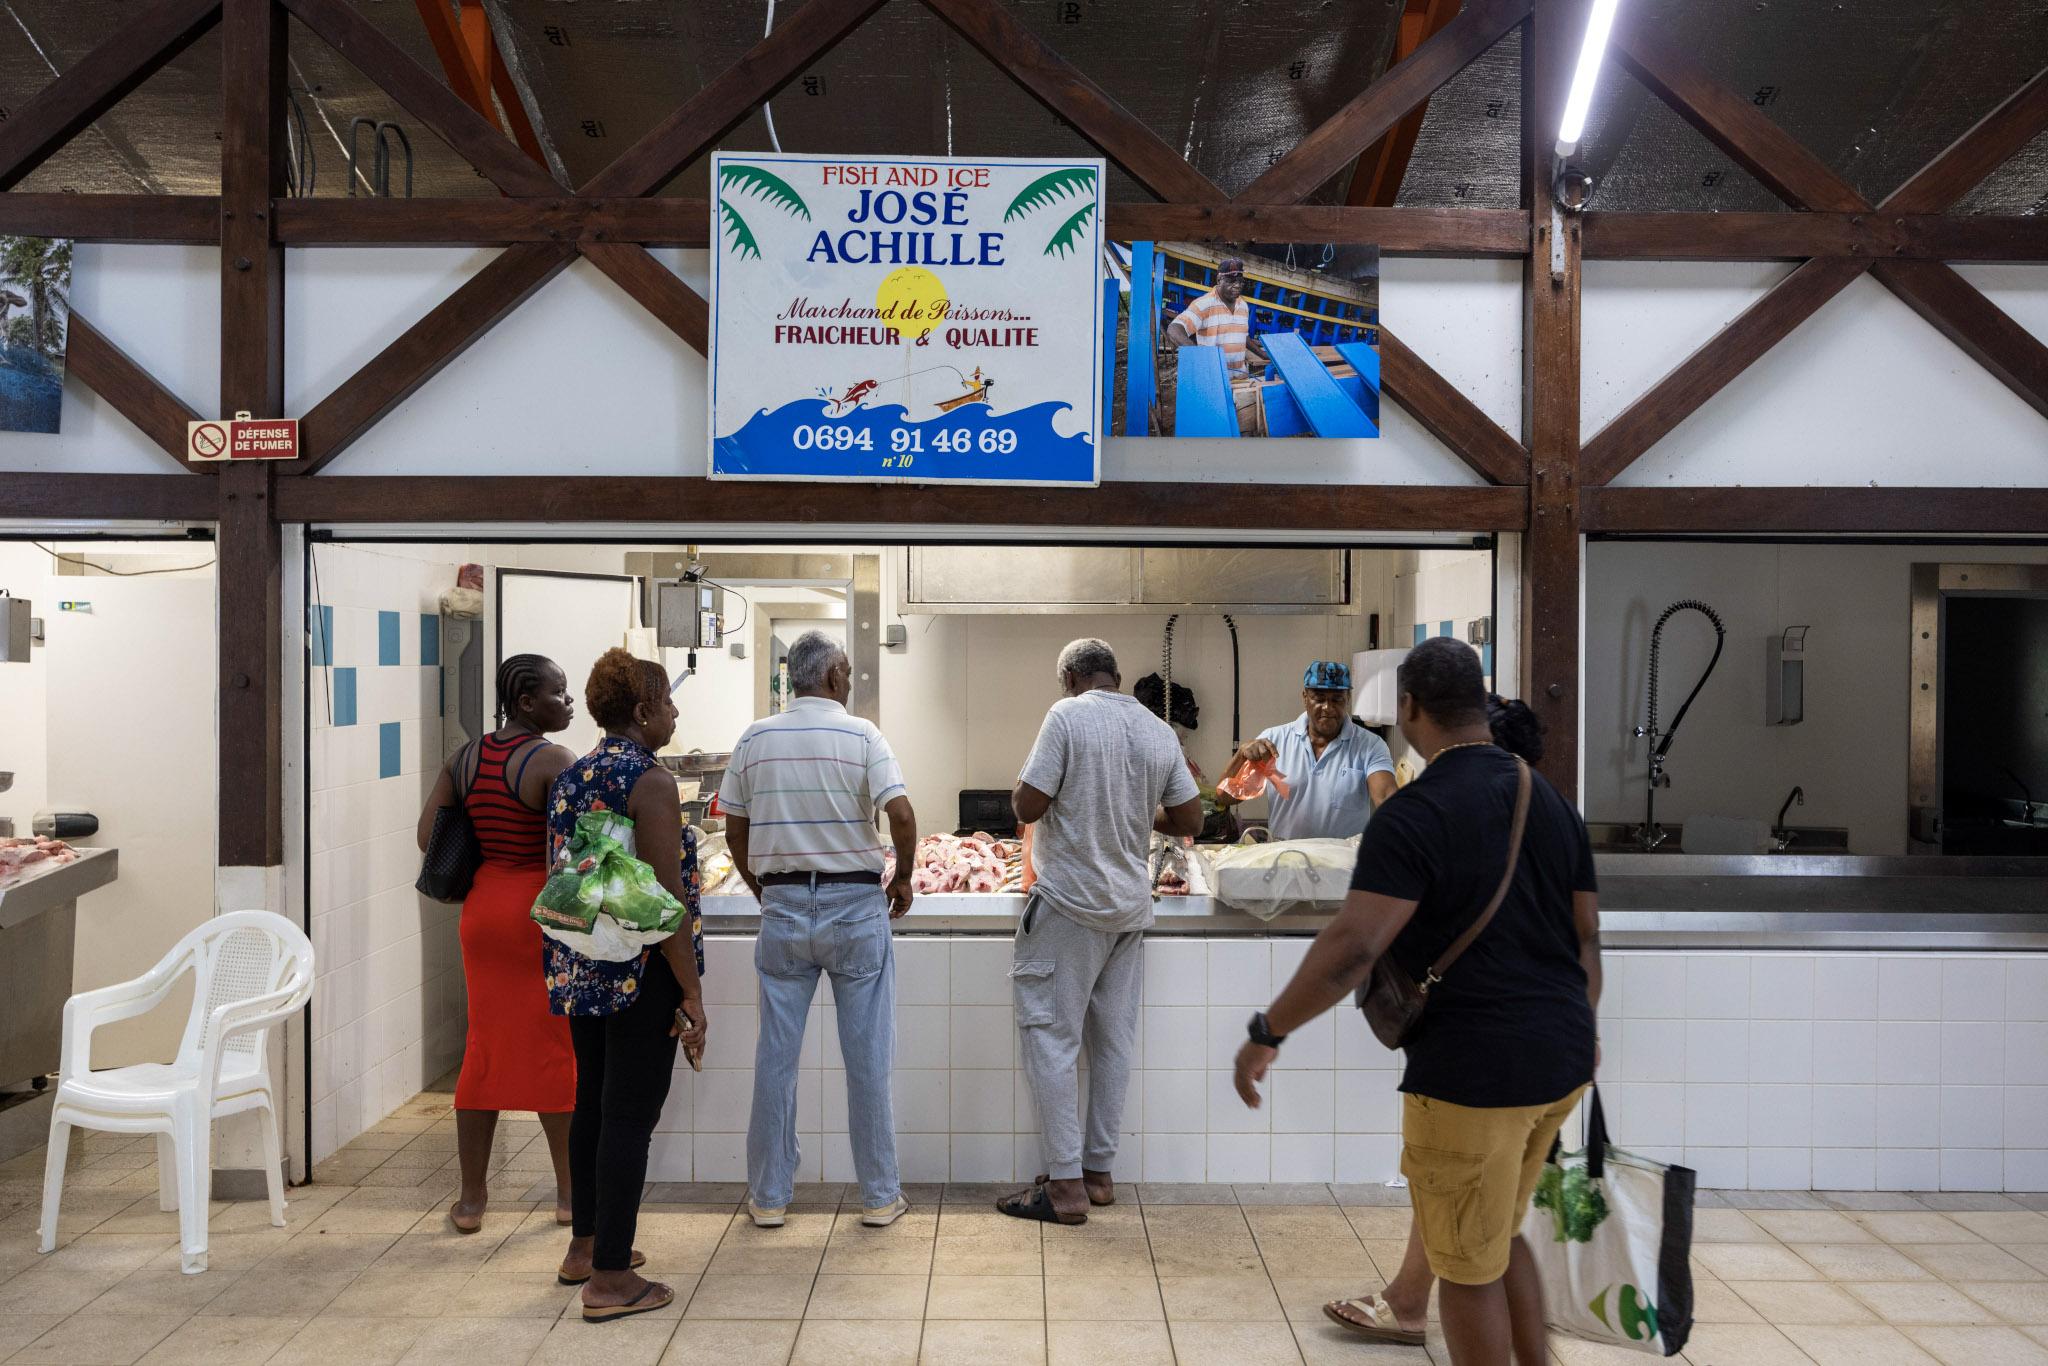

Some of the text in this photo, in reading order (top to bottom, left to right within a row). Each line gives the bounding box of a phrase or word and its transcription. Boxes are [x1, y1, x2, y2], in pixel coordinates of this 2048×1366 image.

[823, 166, 989, 187] FISH AND ICE
[848, 188, 968, 225] JOSÉ
[806, 230, 1004, 265] ACHILLE
[777, 298, 1030, 321] Marchand de Poissons...
[776, 326, 1038, 348] FRAICHEUR & QUALITE
[238, 427, 289, 439] DÉFENSE
[793, 425, 1017, 453] 0694 91 46 69
[235, 440, 292, 450] DE FUMER
[898, 455, 913, 467] 10
